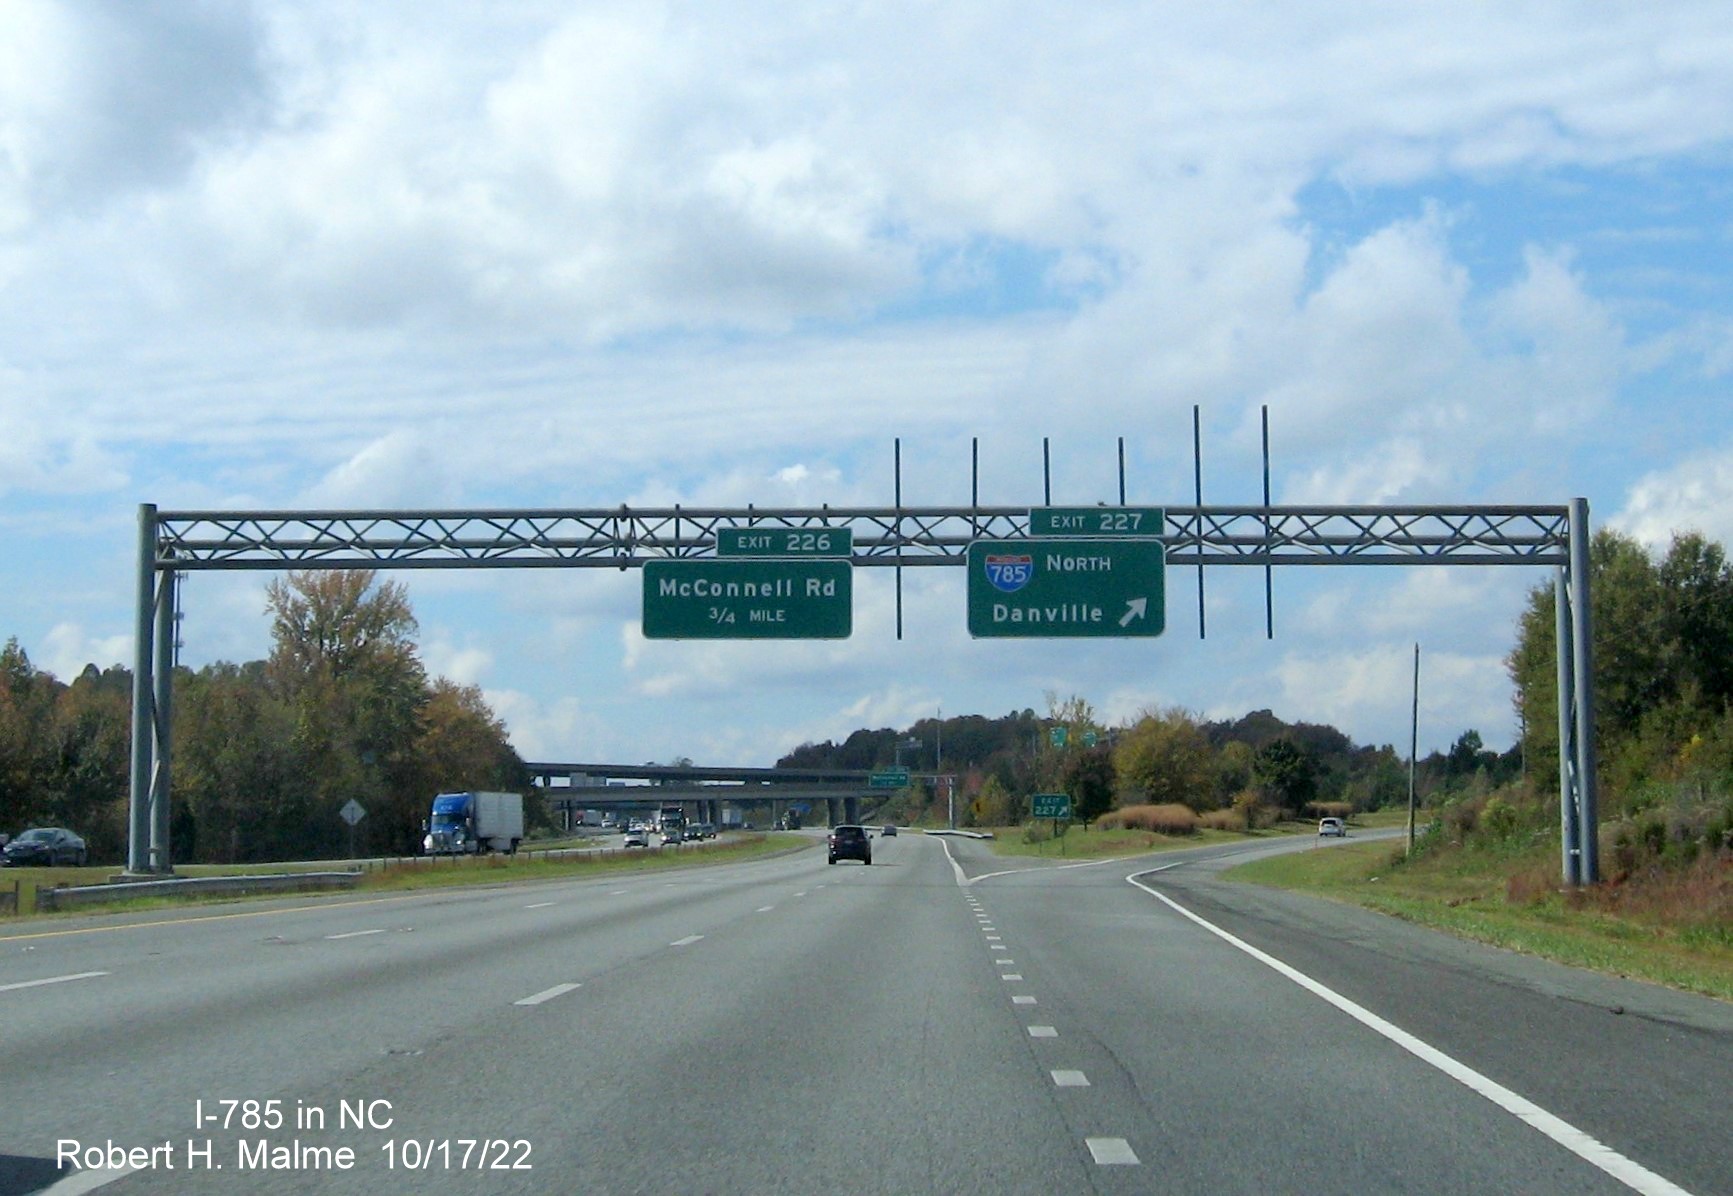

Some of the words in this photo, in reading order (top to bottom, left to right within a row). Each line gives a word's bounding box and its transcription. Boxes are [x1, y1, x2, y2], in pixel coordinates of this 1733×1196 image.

[1051, 515, 1085, 528] EXIT
[1099, 513, 1142, 530] 227
[738, 536, 772, 548] EXIT
[786, 534, 831, 551] 226
[1046, 554, 1111, 571] NORTH
[991, 565, 1027, 583] 785
[659, 578, 792, 597] McConnell
[806, 578, 835, 597] Rd
[750, 609, 786, 622] MILE
[993, 604, 1103, 622] Danville
[1035, 805, 1057, 815] 227
